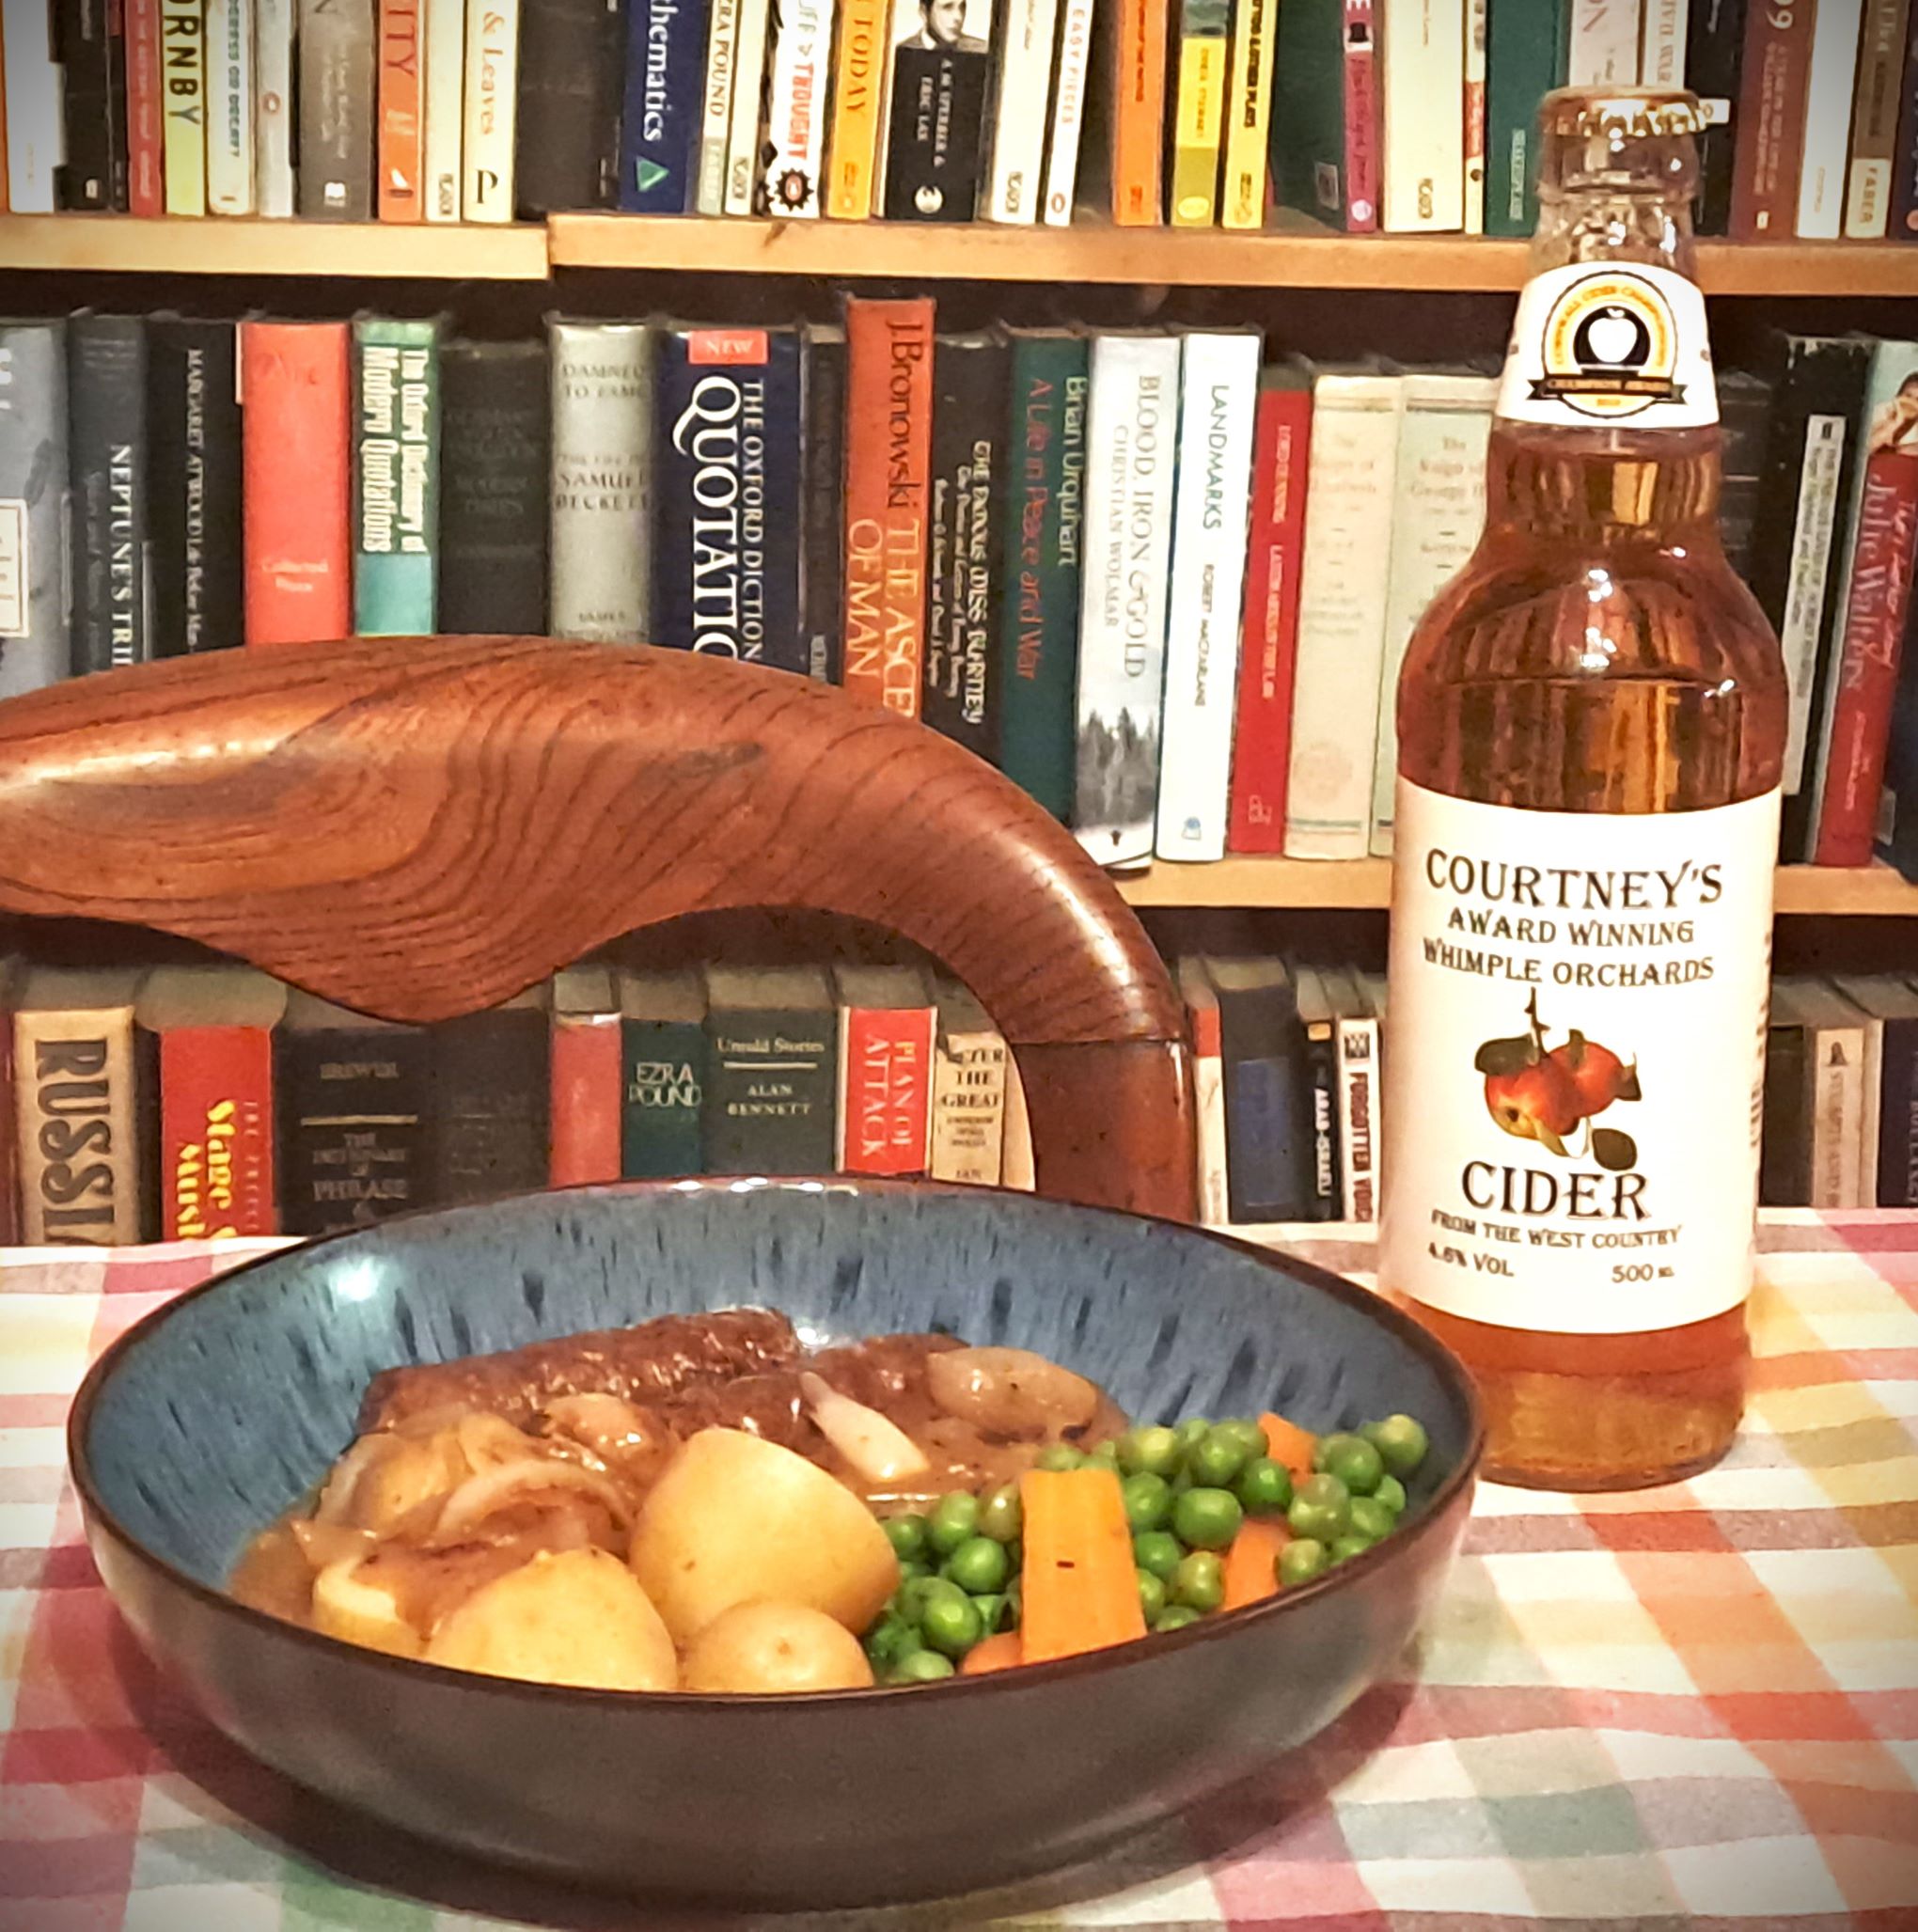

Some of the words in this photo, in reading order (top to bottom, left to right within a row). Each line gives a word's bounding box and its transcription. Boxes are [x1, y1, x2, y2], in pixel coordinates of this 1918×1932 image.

[482, 11, 505, 35] &
[480, 48, 504, 135] Leaves
[709, 39, 731, 118] POUND
[845, 19, 874, 117] TODAY
[401, 349, 429, 379] The
[705, 338, 755, 355] NEW
[187, 348, 204, 447] MARGARET
[363, 345, 400, 433] Modern
[401, 383, 430, 441] Oxford
[743, 378, 765, 430] THE
[1032, 378, 1055, 398] A
[1063, 376, 1088, 445] Brian
[1027, 403, 1054, 451] Life
[1203, 385, 1230, 531] LANDMARKS
[186, 453, 205, 535] ATWOOD
[359, 438, 400, 553] Quotations
[397, 445, 430, 532] Dictionary
[742, 434, 765, 543] OXFORD
[1028, 456, 1047, 479] in
[1108, 425, 1129, 532] CHRISTIAN
[110, 444, 134, 603] NEPTUNE'S
[1022, 487, 1048, 558] Peace
[1055, 451, 1085, 566] Urquhart
[1130, 490, 1156, 560] IRON
[1863, 473, 1898, 561] Julie
[849, 518, 883, 573] OF
[887, 517, 920, 599] THE
[967, 566, 990, 623] MISS
[1019, 571, 1045, 623] and
[1104, 540, 1124, 628] WOLMAR
[846, 581, 881, 677] MAN
[1016, 630, 1041, 682] War
[1124, 599, 1150, 678] GOLD
[1844, 564, 1889, 692] Walters
[883, 607, 918, 718] ASCE
[1194, 619, 1210, 707] MACFARLANE
[1425, 847, 1723, 911] COURTNEY'S
[1448, 906, 1557, 944] AWARD
[1568, 919, 1695, 948] WINNING
[1422, 936, 1543, 982] WHIMPLE
[1552, 956, 1715, 988] ORCHARDS
[628, 1083, 702, 1107] POUND
[636, 1061, 695, 1085] EZRA
[747, 1083, 794, 1097] ALAN
[860, 1034, 890, 1157] ATTACK
[892, 1040, 917, 1108] PLAN
[940, 1092, 999, 1108] GREAT
[956, 1070, 993, 1085] THE
[727, 1102, 811, 1116] BENNETT
[1461, 1160, 1652, 1221] CIDER
[1431, 1209, 1477, 1235] FROM
[1483, 1221, 1522, 1244] THE
[1528, 1228, 1587, 1249] WEST
[1592, 1225, 1684, 1249] COUNTRY
[1472, 1253, 1516, 1278] VOL
[1611, 1264, 1655, 1283] 500
